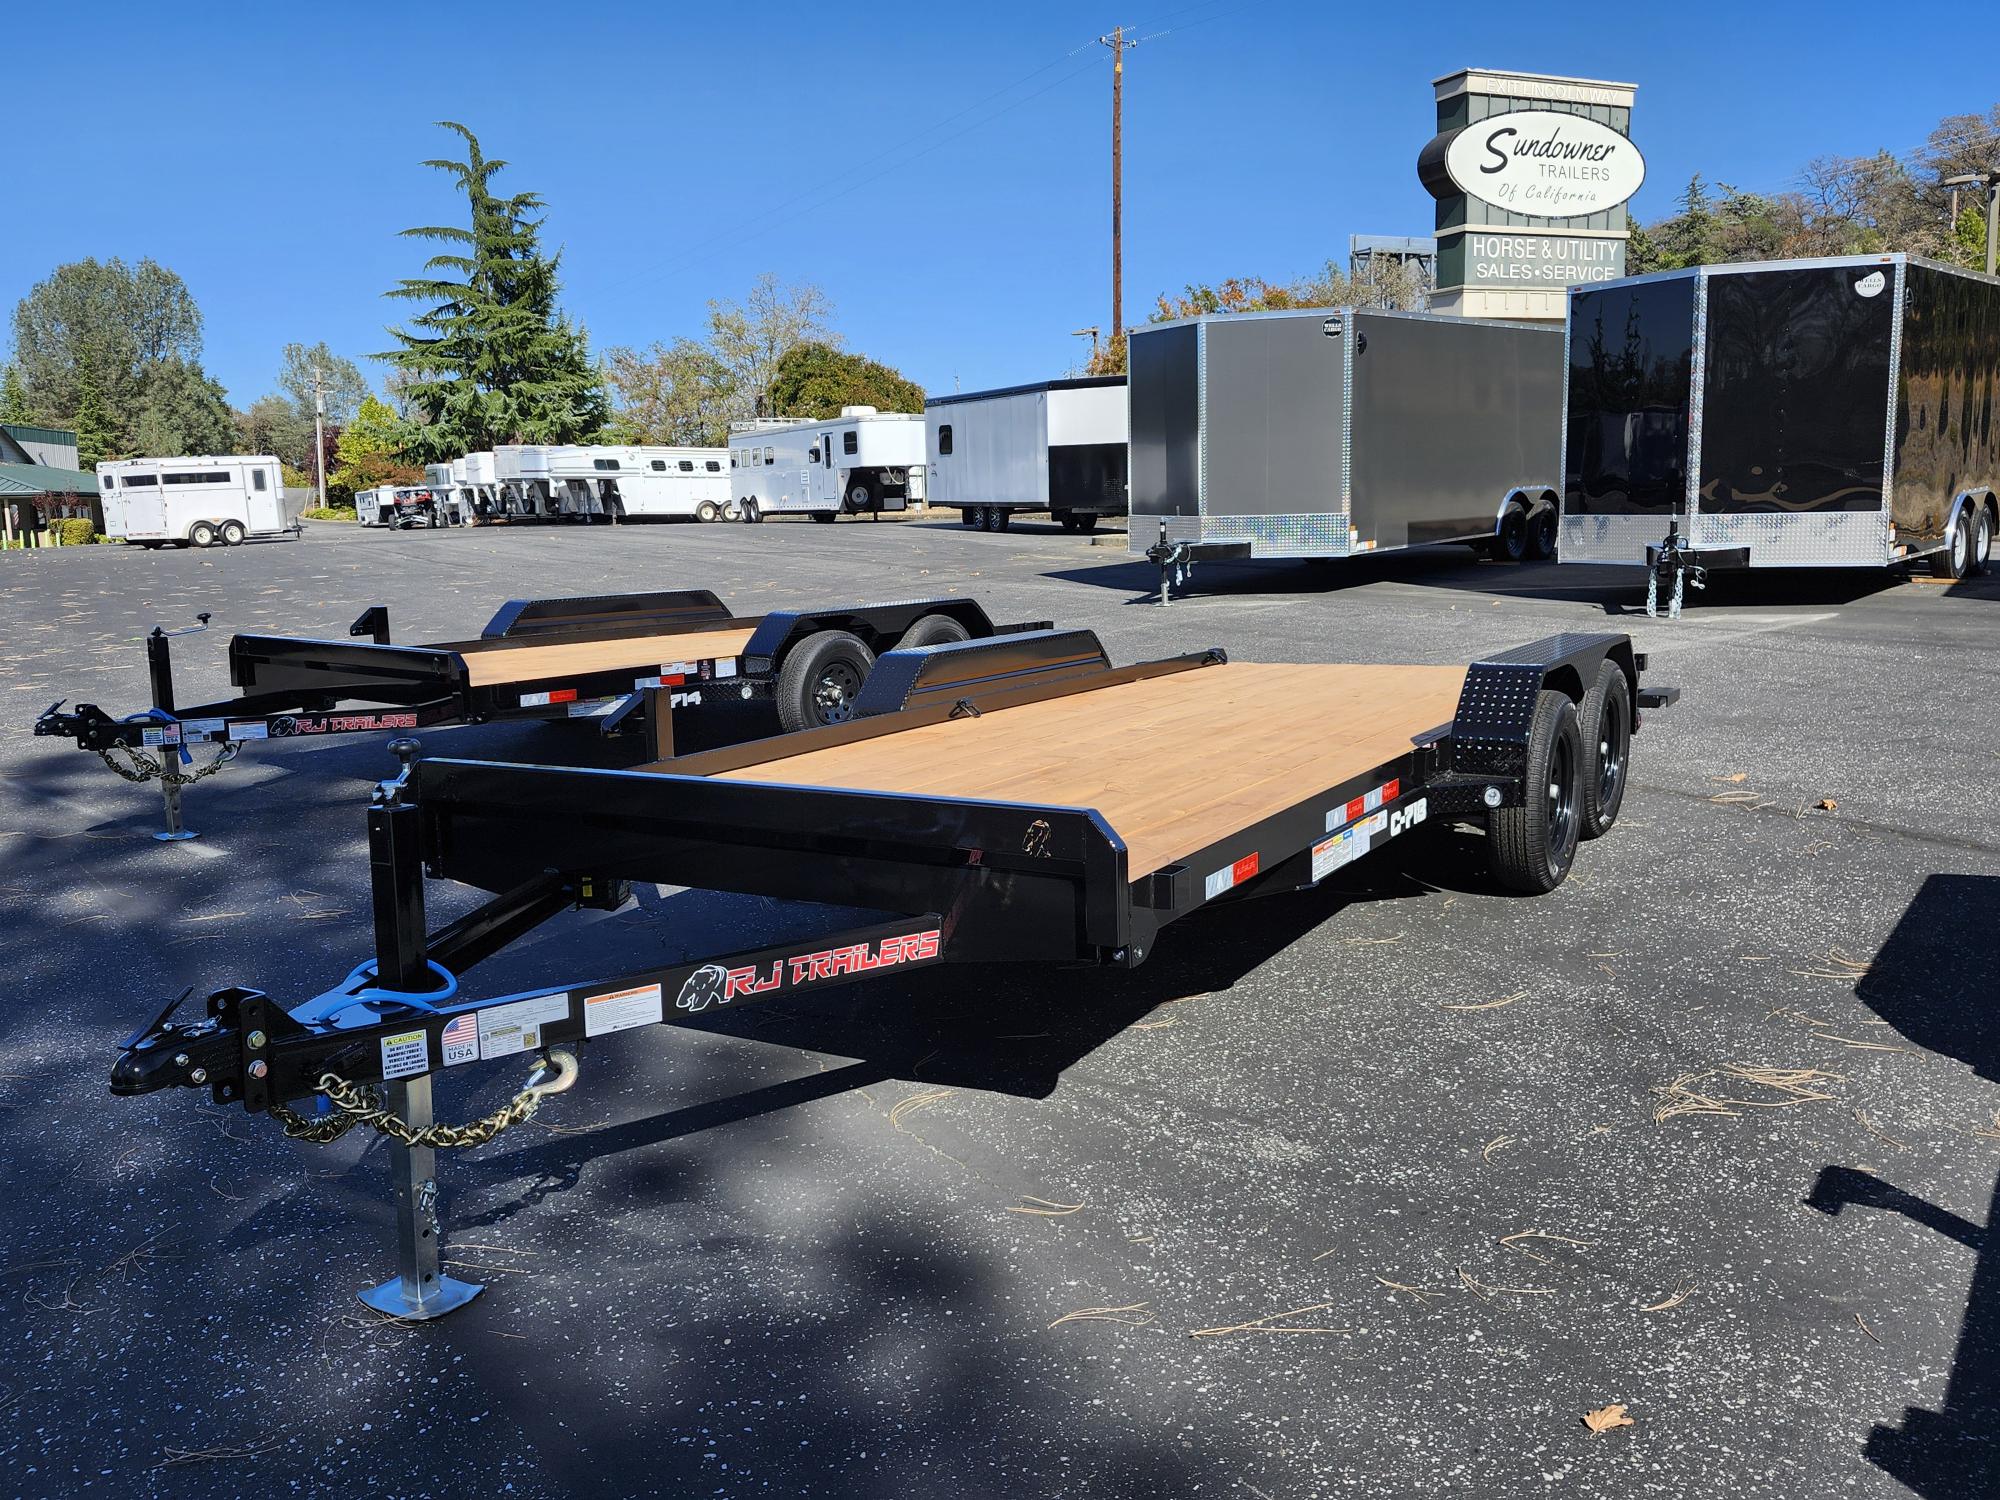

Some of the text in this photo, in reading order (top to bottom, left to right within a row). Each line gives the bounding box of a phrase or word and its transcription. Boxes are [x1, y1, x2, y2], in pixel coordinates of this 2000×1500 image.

[1486, 78, 1618, 104] EXIT LINCOLN WAY
[1480, 126, 1616, 174] Sundowner
[1539, 163, 1610, 181] TRAILERS
[1498, 183, 1597, 204] Of California
[1473, 236, 1619, 261] HORSE & UTILITY
[295, 714, 417, 734] RJ TRAILERS
[724, 929, 940, 1000] RJ TRAILERS
[393, 1033, 422, 1044] CAUTION
[447, 1044, 465, 1052] MADE
[448, 1048, 473, 1060] USA
